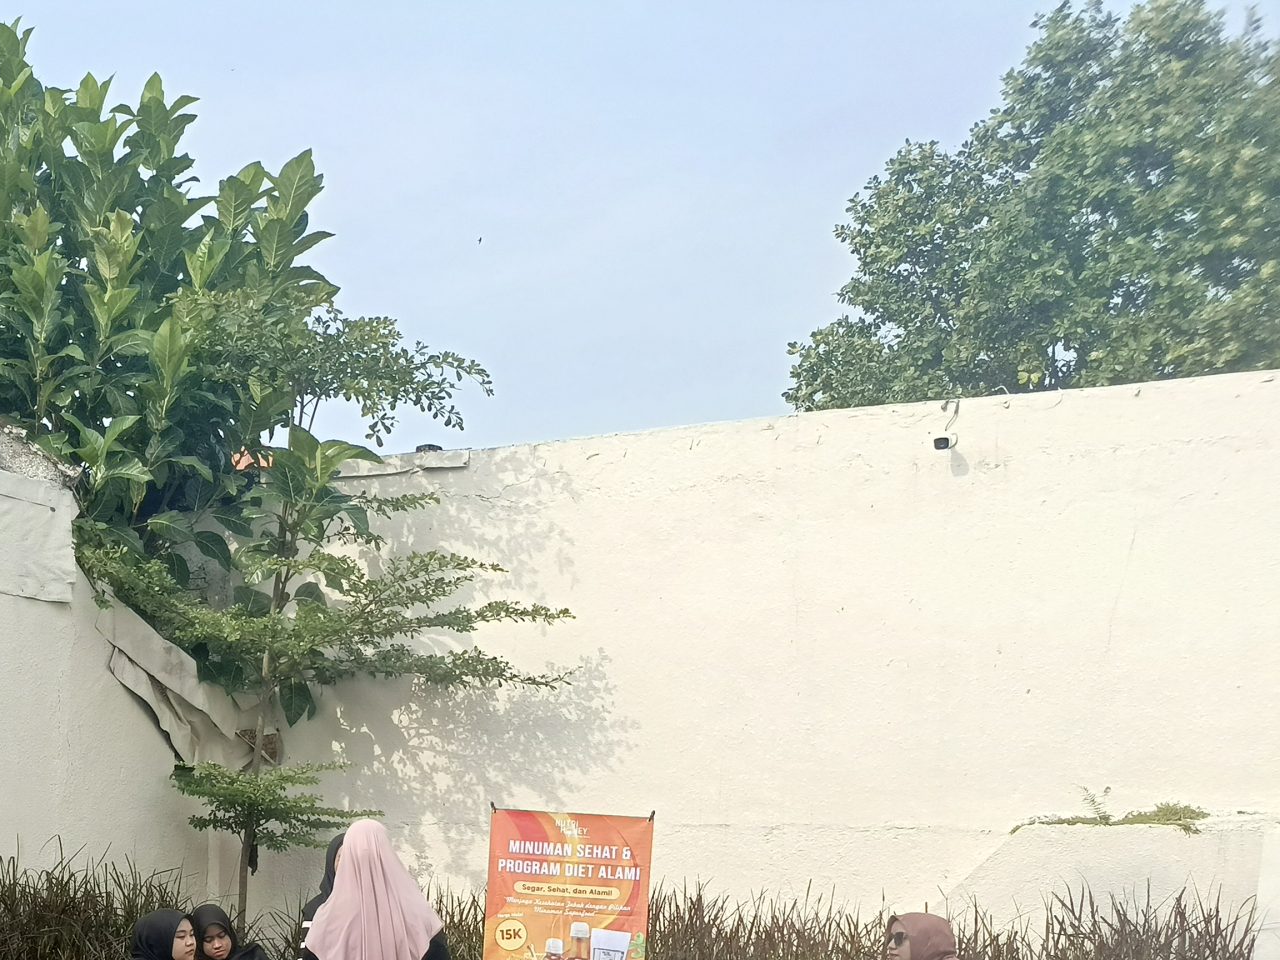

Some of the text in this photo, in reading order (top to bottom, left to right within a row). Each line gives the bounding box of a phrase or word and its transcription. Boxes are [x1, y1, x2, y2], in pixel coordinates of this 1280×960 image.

[509, 839, 632, 860] MINUMAN SEHAT &
[498, 859, 641, 880] PROGRAM DIET ALAMI
[573, 887, 587, 895] dan
[499, 928, 523, 940] 15K
